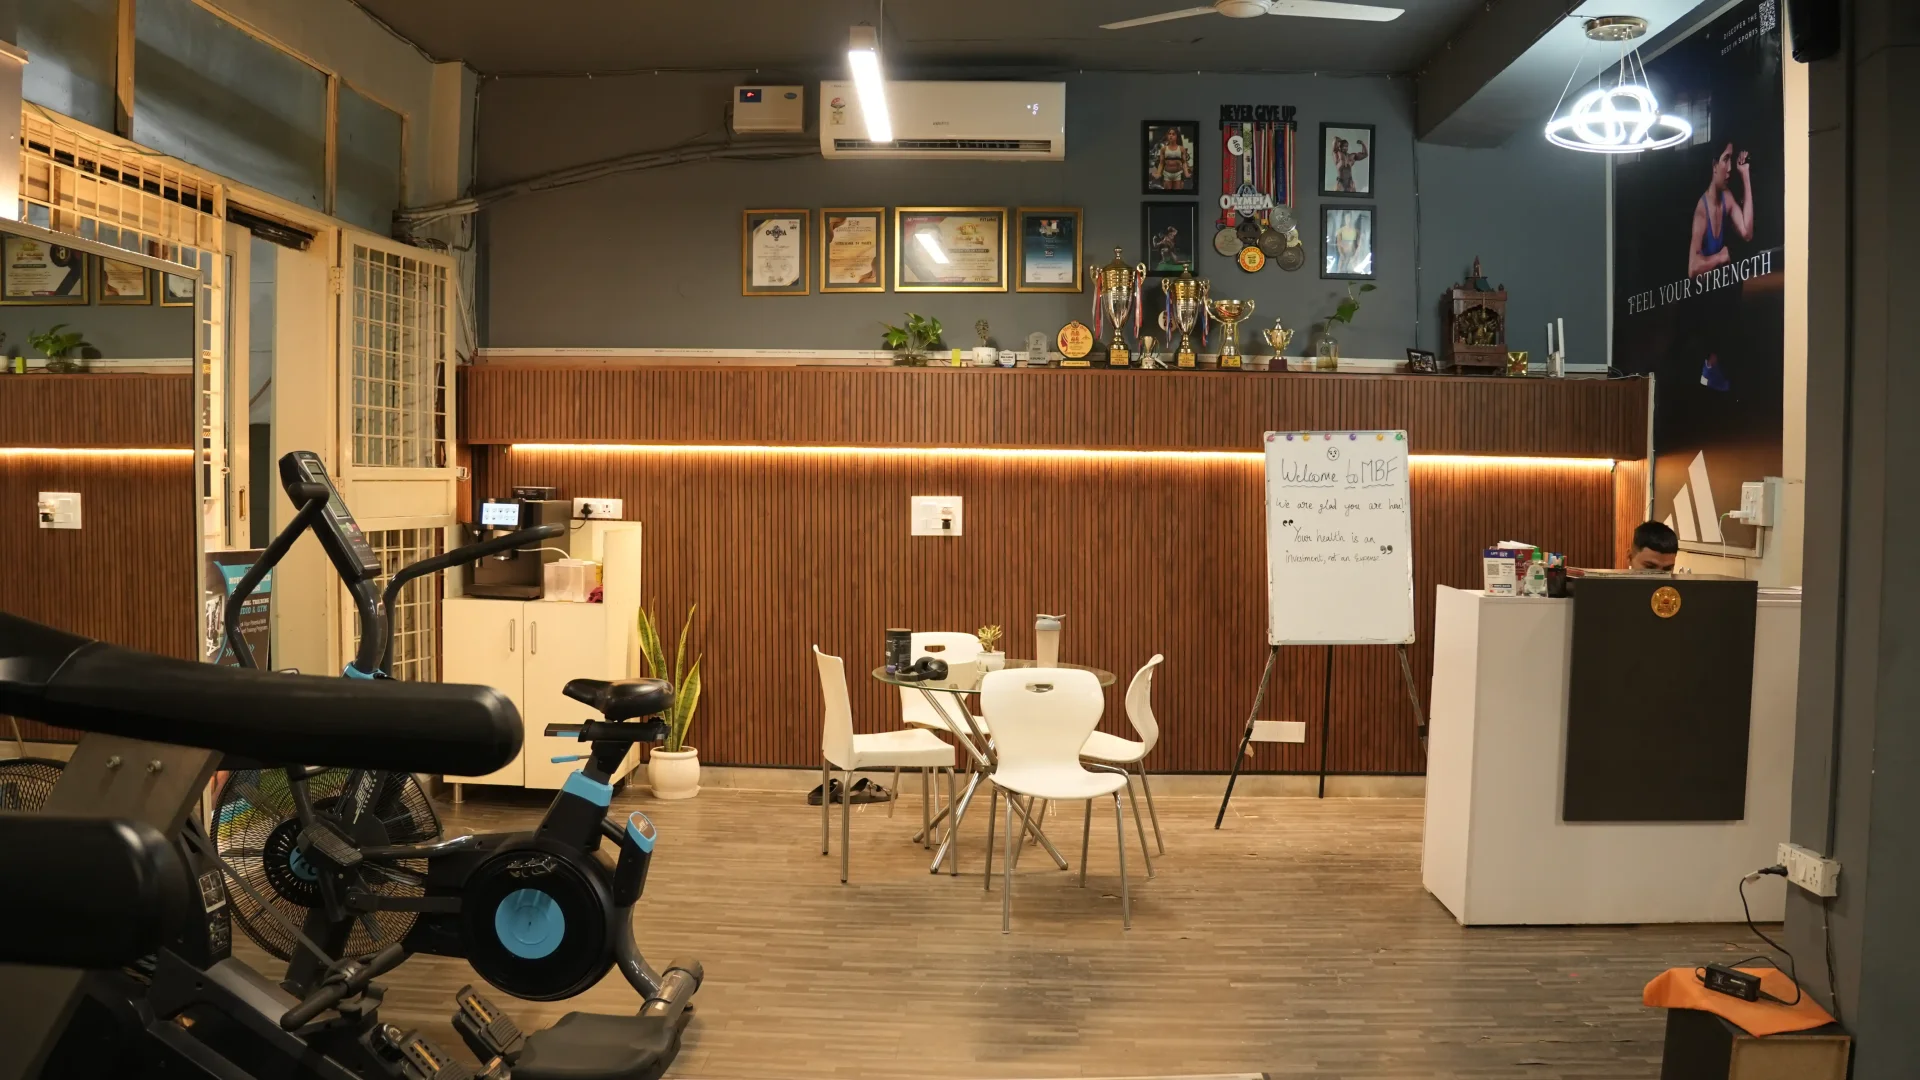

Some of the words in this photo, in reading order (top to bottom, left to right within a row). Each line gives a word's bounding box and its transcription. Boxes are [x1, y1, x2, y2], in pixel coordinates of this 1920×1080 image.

[1723, 20, 1746, 40] DISCOVER
[1747, 12, 1757, 23] THE
[1721, 44, 1732, 56] BEST
[1732, 40, 1738, 49] IN
[1738, 27, 1758, 44] SPORTS
[1220, 104, 1253, 121] NEVER
[1254, 105, 1280, 121] GIVE
[1281, 105, 1297, 121] UP
[1219, 193, 1275, 209] OLYMPIA
[1627, 290, 1656, 315] FEEL
[1659, 278, 1692, 305] YOUR
[1695, 251, 1772, 295] STRENGTH
[1281, 458, 1339, 483] Welcome
[1345, 459, 1359, 484] to
[1361, 456, 1398, 484] MBF
[1275, 497, 1291, 509] We
[1296, 502, 1313, 510] are
[1318, 498, 1337, 514] glad
[1344, 503, 1361, 517] you
[1368, 502, 1383, 510] are
[1316, 529, 1345, 543] health
[1351, 532, 1359, 544] is
[1364, 535, 1376, 544] an
[1327, 552, 1341, 561] not
